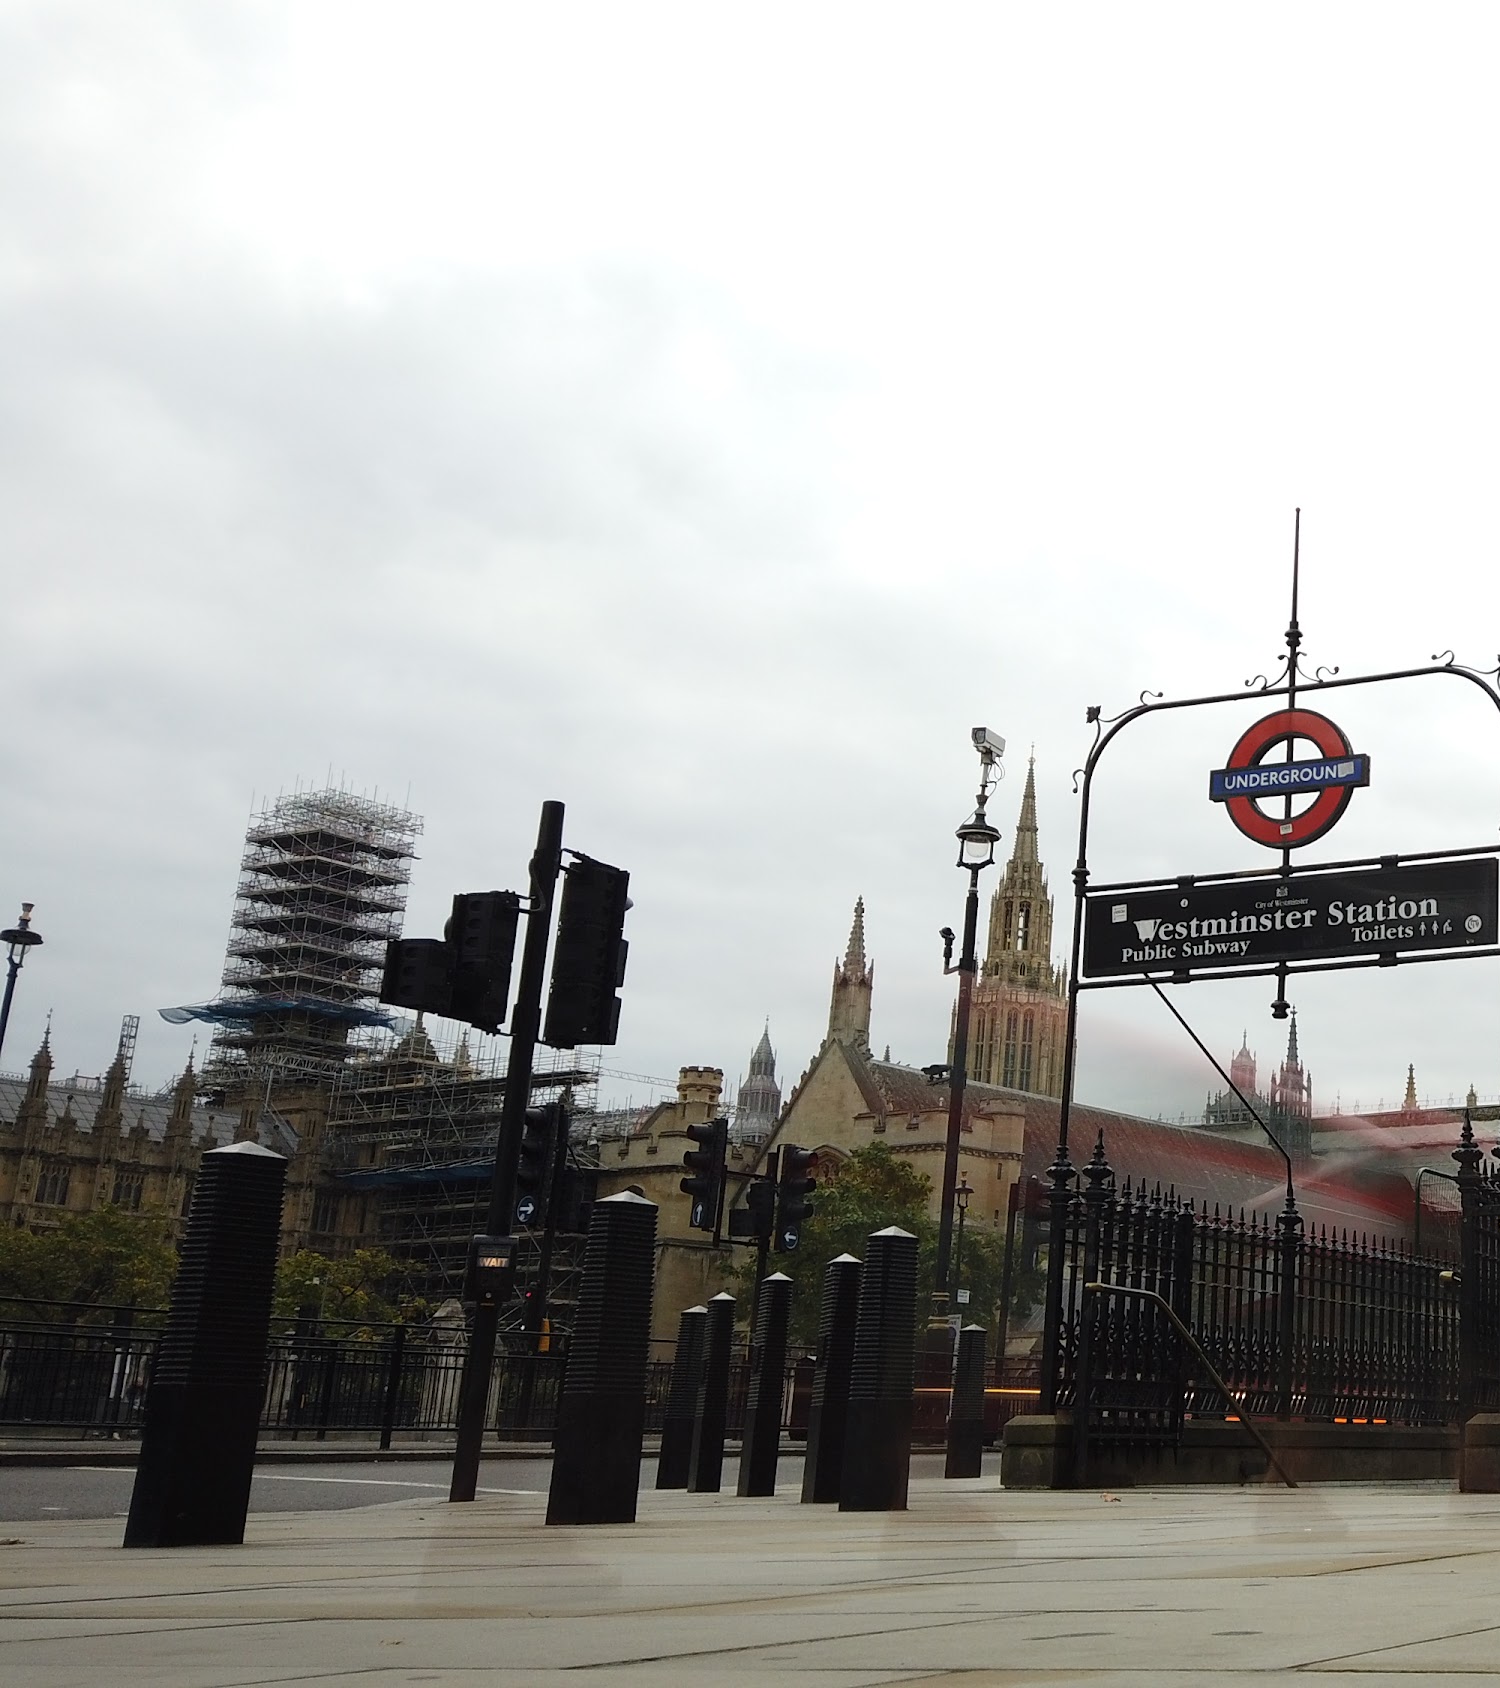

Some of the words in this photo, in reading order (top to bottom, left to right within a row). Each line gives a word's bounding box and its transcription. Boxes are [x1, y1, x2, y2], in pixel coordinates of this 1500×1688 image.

[1224, 762, 1346, 790] UNDERGROUN
[1133, 908, 1317, 943] Westminster
[1327, 896, 1439, 926] Station
[1351, 924, 1414, 942] Toilets
[1121, 943, 1176, 963] Public
[1181, 939, 1251, 957] Subway
[480, 1257, 508, 1267] WAIT
